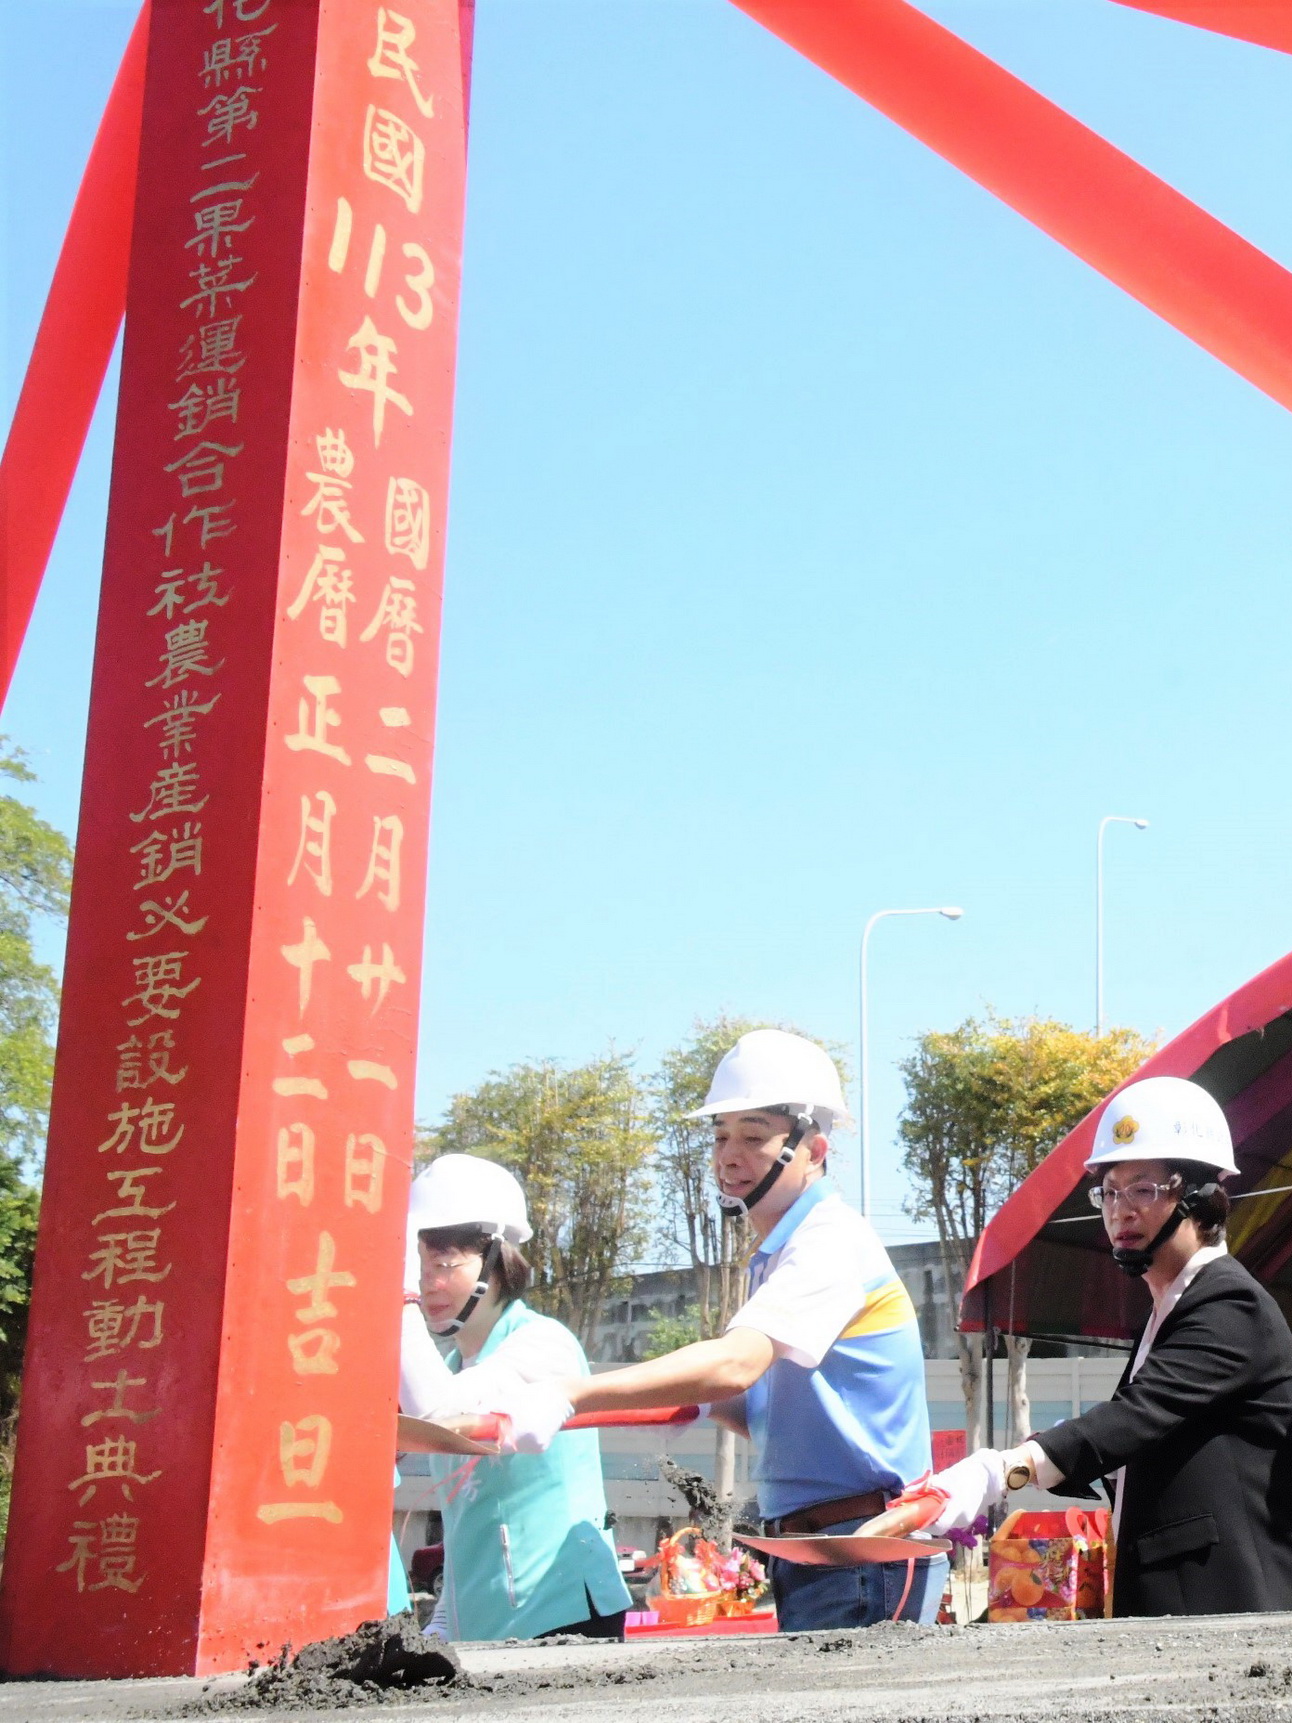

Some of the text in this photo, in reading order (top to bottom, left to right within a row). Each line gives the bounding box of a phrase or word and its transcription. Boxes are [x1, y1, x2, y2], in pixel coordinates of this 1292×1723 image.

[327, 7, 436, 449] 民國113年
[272, 427, 367, 1208] 農曆正月十二日
